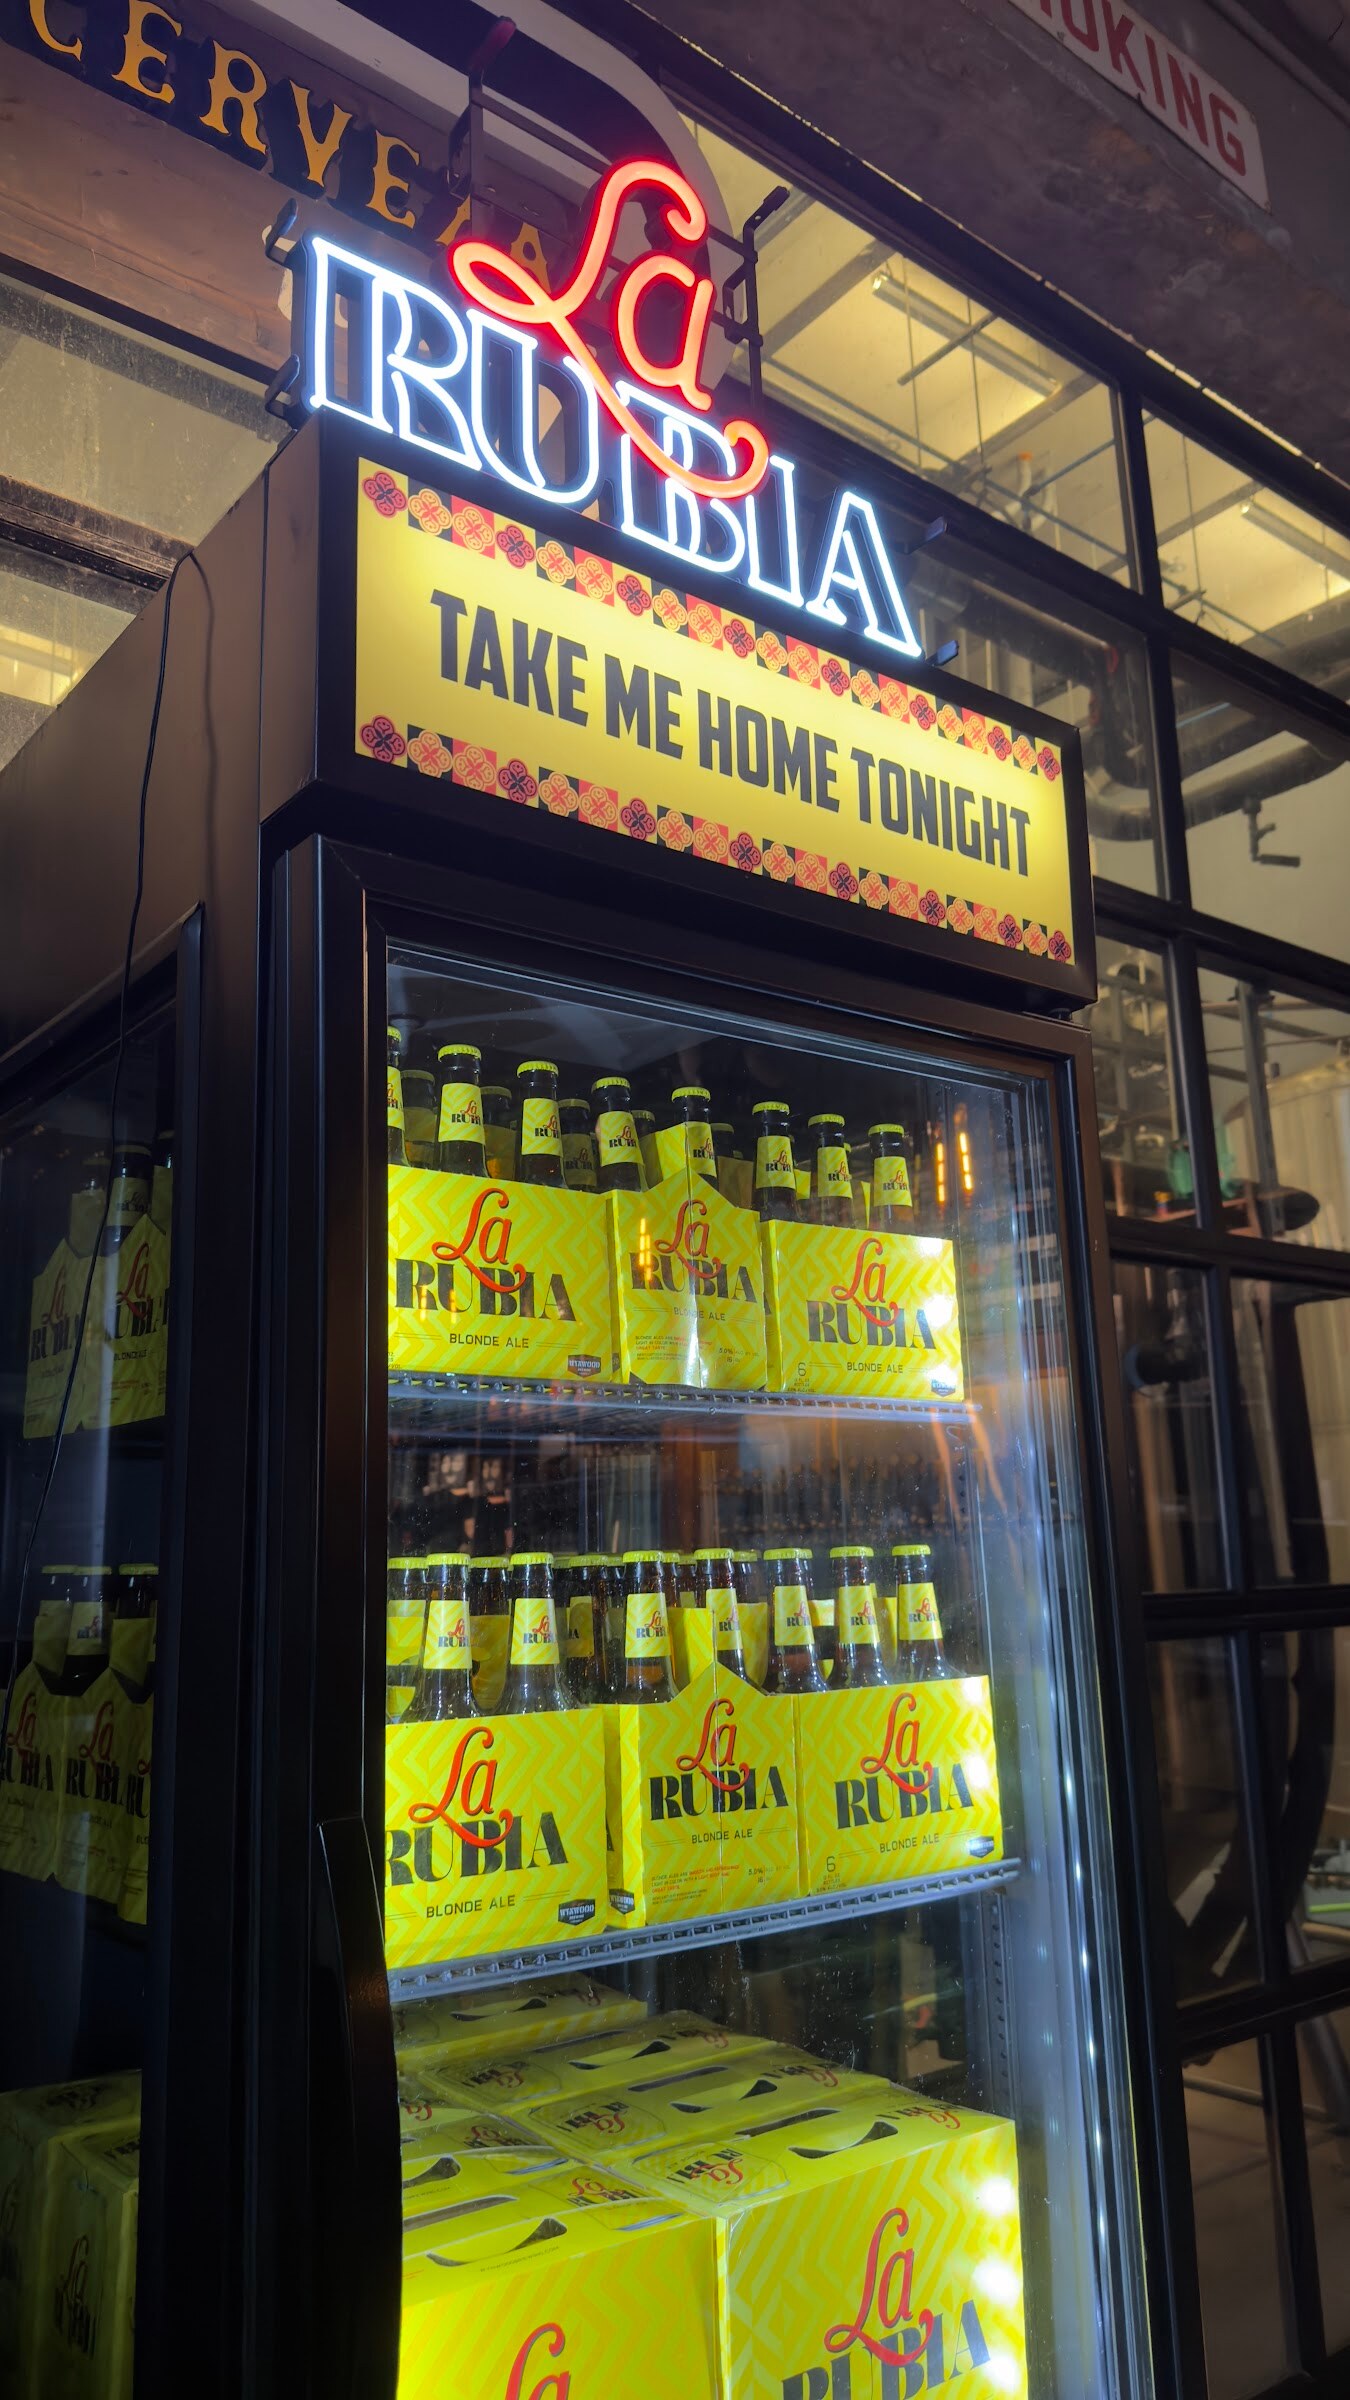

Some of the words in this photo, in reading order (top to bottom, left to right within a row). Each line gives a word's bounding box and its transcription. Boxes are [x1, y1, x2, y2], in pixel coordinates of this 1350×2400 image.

[1040, 0, 1246, 177] OKING
[29, 0, 552, 294] CERVEA
[452, 160, 768, 498] La
[310, 235, 922, 657] RUBIA
[430, 589, 590, 726] TAKE
[605, 654, 684, 760] ME
[698, 689, 840, 812] HOME
[850, 747, 1032, 877] TONIGHT
[431, 1187, 526, 1293] La
[654, 1199, 721, 1279] La
[395, 1258, 577, 1322] RUBIA
[628, 1252, 758, 1304] RUBIA
[831, 1238, 899, 1328] La
[450, 1333, 500, 1347] BLONDE
[506, 1337, 530, 1349] ALE
[709, 1311, 726, 1321] ALE
[806, 1300, 937, 1350] RUBIA
[797, 1361, 807, 1377] 6
[847, 1362, 879, 1374] BLONDE
[883, 1364, 904, 1375] ALE
[676, 1698, 750, 1791] La
[861, 1692, 933, 1794] La
[408, 1726, 514, 1848] La
[650, 1766, 790, 1821] RUBIA
[834, 1763, 974, 1830] RUBIA
[692, 1831, 731, 1844] BLONDE
[734, 1829, 754, 1840] ALE
[826, 1855, 836, 1872] 6
[879, 1837, 920, 1853] BLONDE
[922, 1834, 940, 1846] ALE
[426, 1899, 482, 1918] BLONDE
[489, 1895, 516, 1909] ALE
[824, 2207, 934, 2366] La
